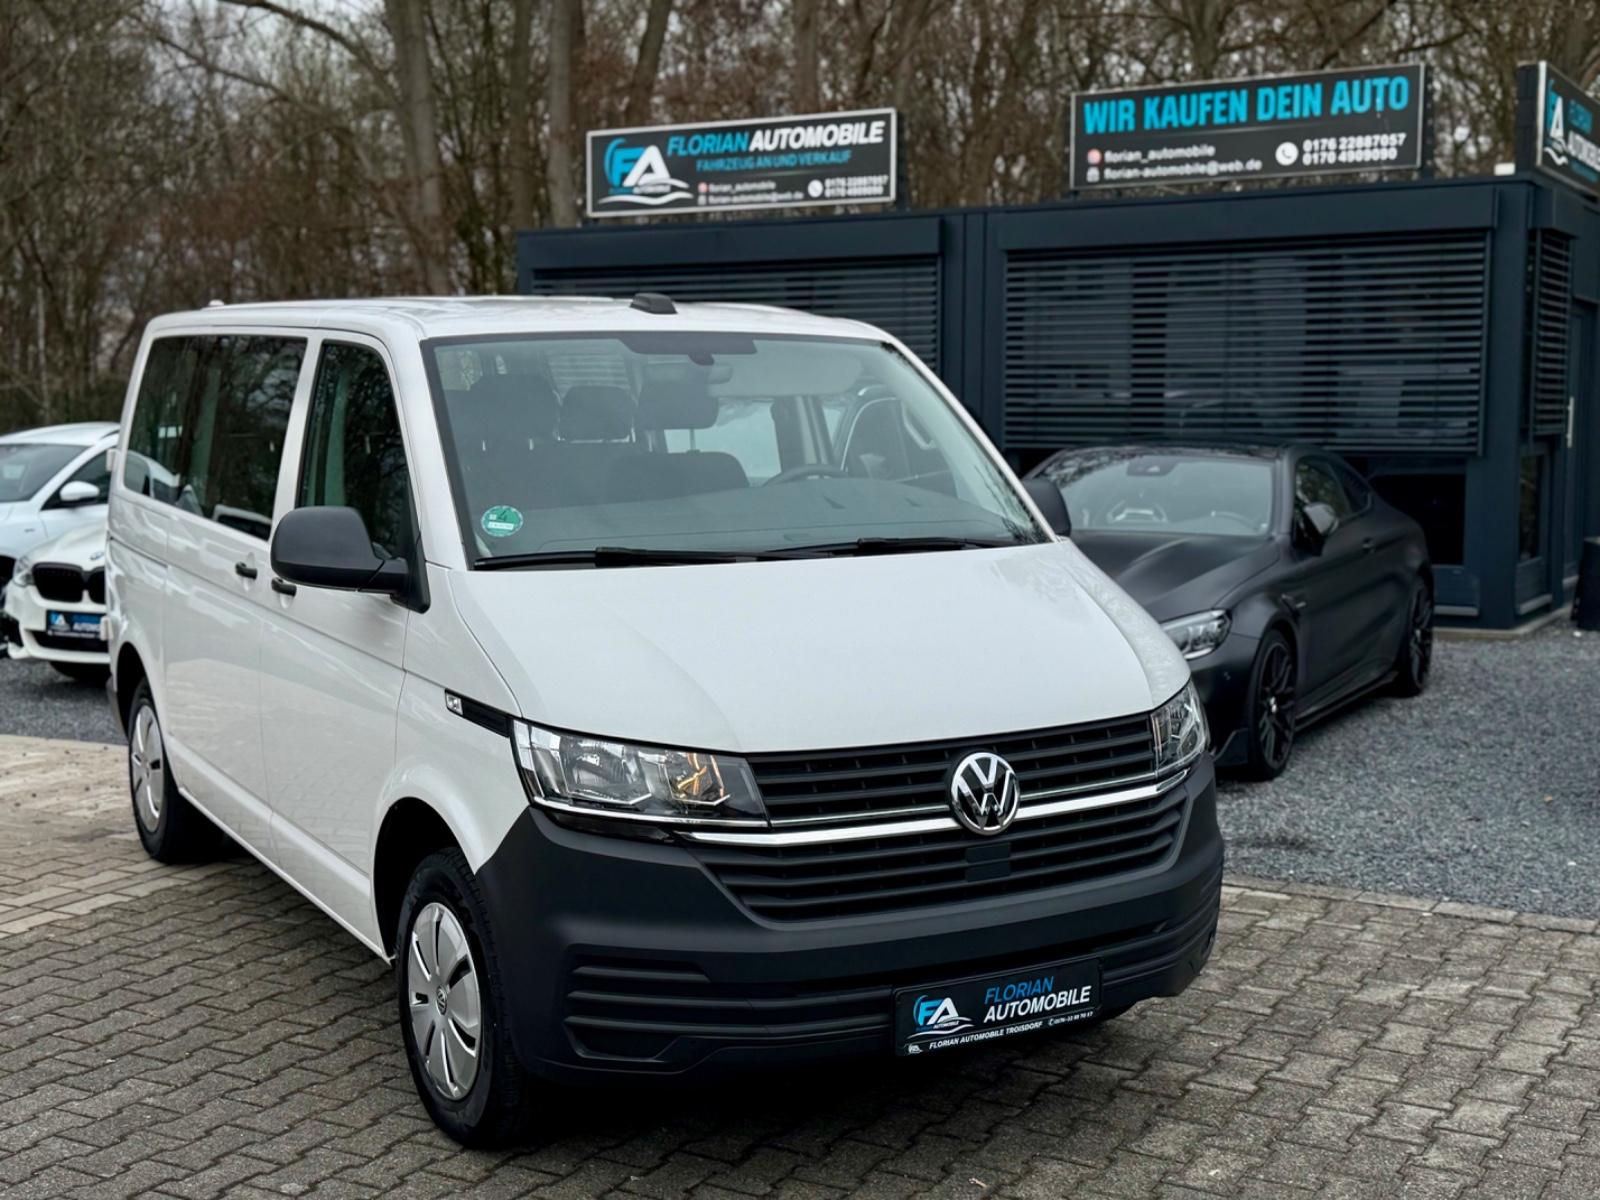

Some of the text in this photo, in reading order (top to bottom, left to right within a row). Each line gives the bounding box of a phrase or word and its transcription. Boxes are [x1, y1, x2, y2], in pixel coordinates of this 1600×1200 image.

[1084, 75, 1409, 134] WIR KAUFEN DEIN AUTO
[667, 120, 886, 156] FLORIAN AUTOMOBILE
[1302, 137, 1337, 152] 0176
[607, 142, 672, 188] FA
[696, 149, 853, 172] FAHRZEUG AN UND VERKAUF
[1302, 150, 1337, 165] 0170
[983, 985, 1092, 1023] AUTOMOBILE
[984, 976, 1055, 1005] FLORIAN
[915, 996, 959, 1025] FA
[929, 1038, 959, 1050] FLORIAN
[960, 1029, 1004, 1044] AUTOMOBILE
[1006, 1021, 1043, 1035] TROISDORF
